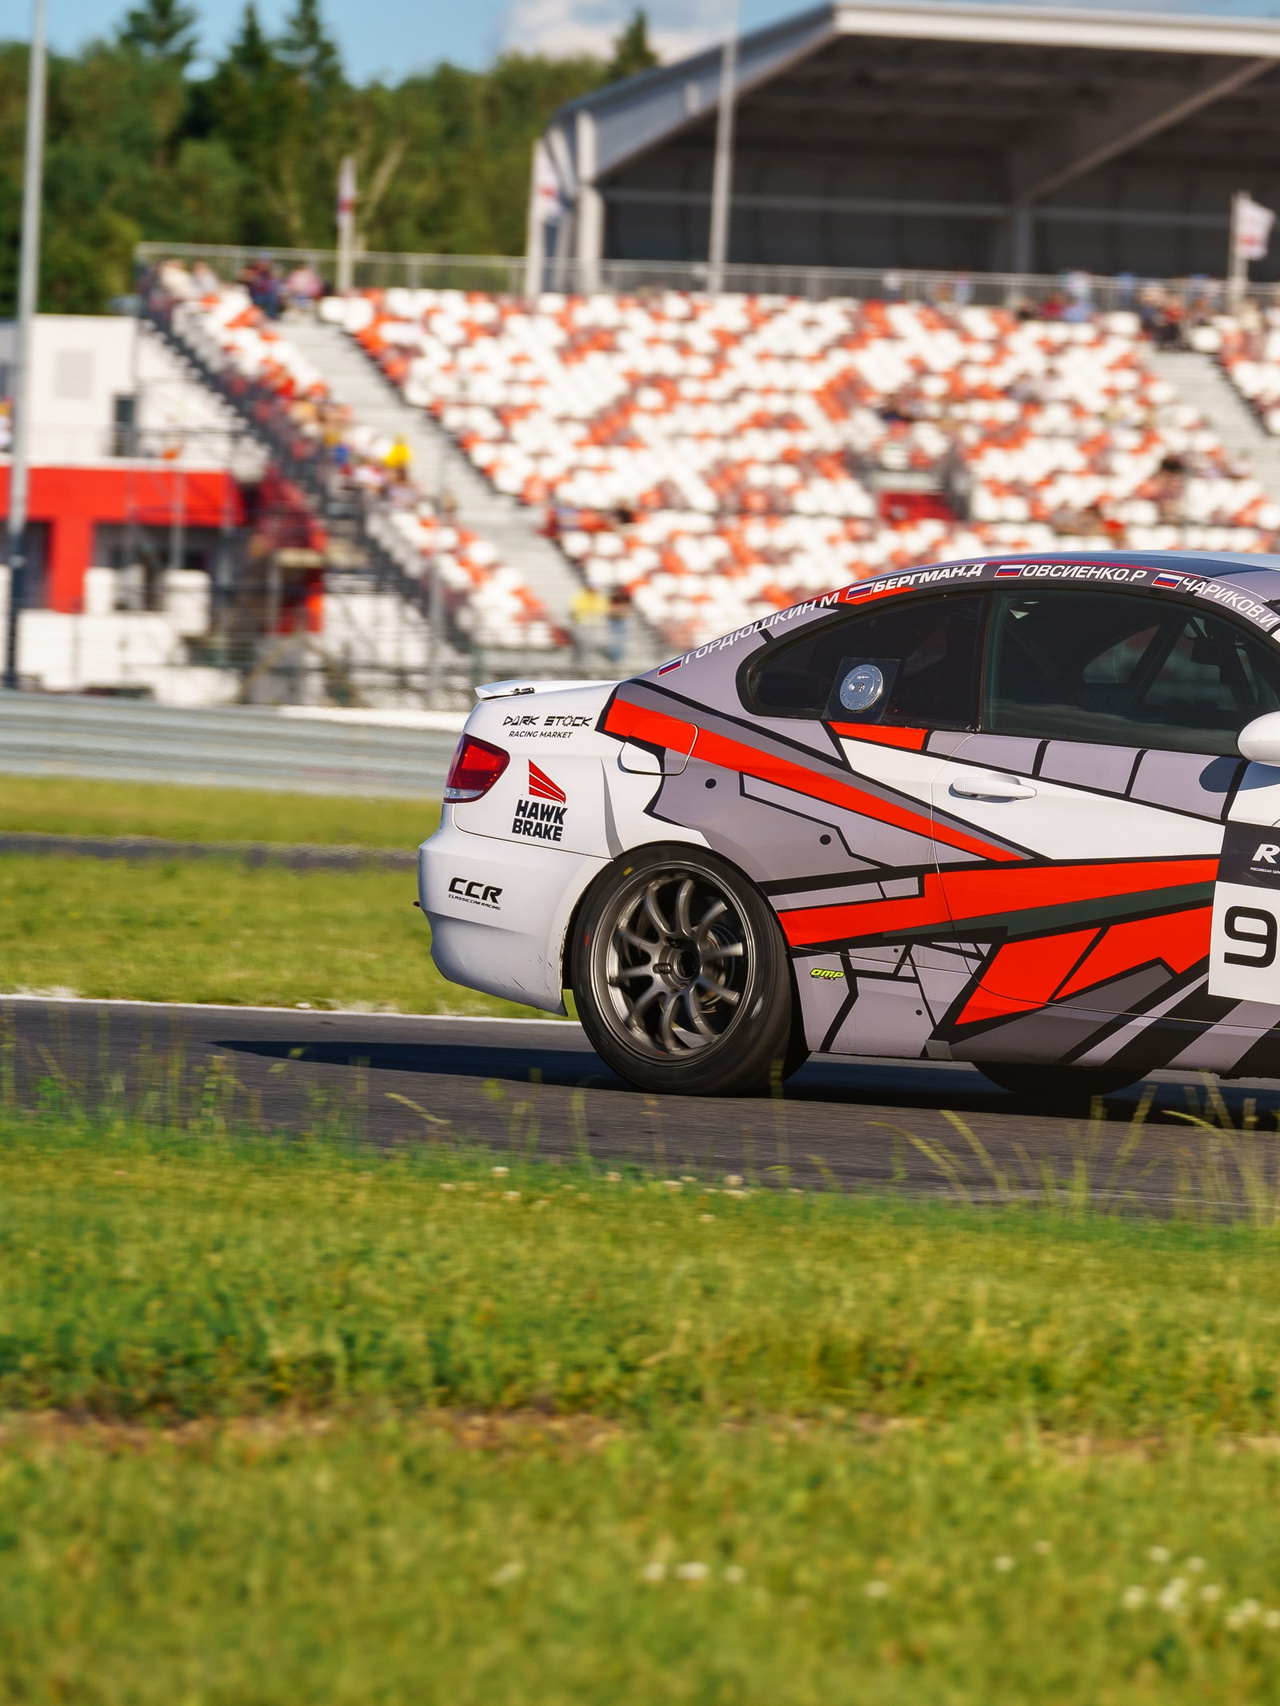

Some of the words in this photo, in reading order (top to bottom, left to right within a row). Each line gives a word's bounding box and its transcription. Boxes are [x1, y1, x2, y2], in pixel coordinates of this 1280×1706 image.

[873, 563, 987, 593] БЕРГМАН.Д
[1022, 564, 1148, 582] ОВСИЕНКО.Р
[1182, 577, 1280, 628] ЧАРИКОВ.И
[685, 602, 817, 664] ГОРДЮШКИН
[502, 715, 541, 727] DARK
[543, 715, 594, 727] STOCK
[508, 730, 539, 738] RACING
[539, 731, 574, 739] MARKET
[515, 799, 568, 825] HAWK
[511, 818, 564, 842] BRAKE
[448, 877, 503, 904] CCR
